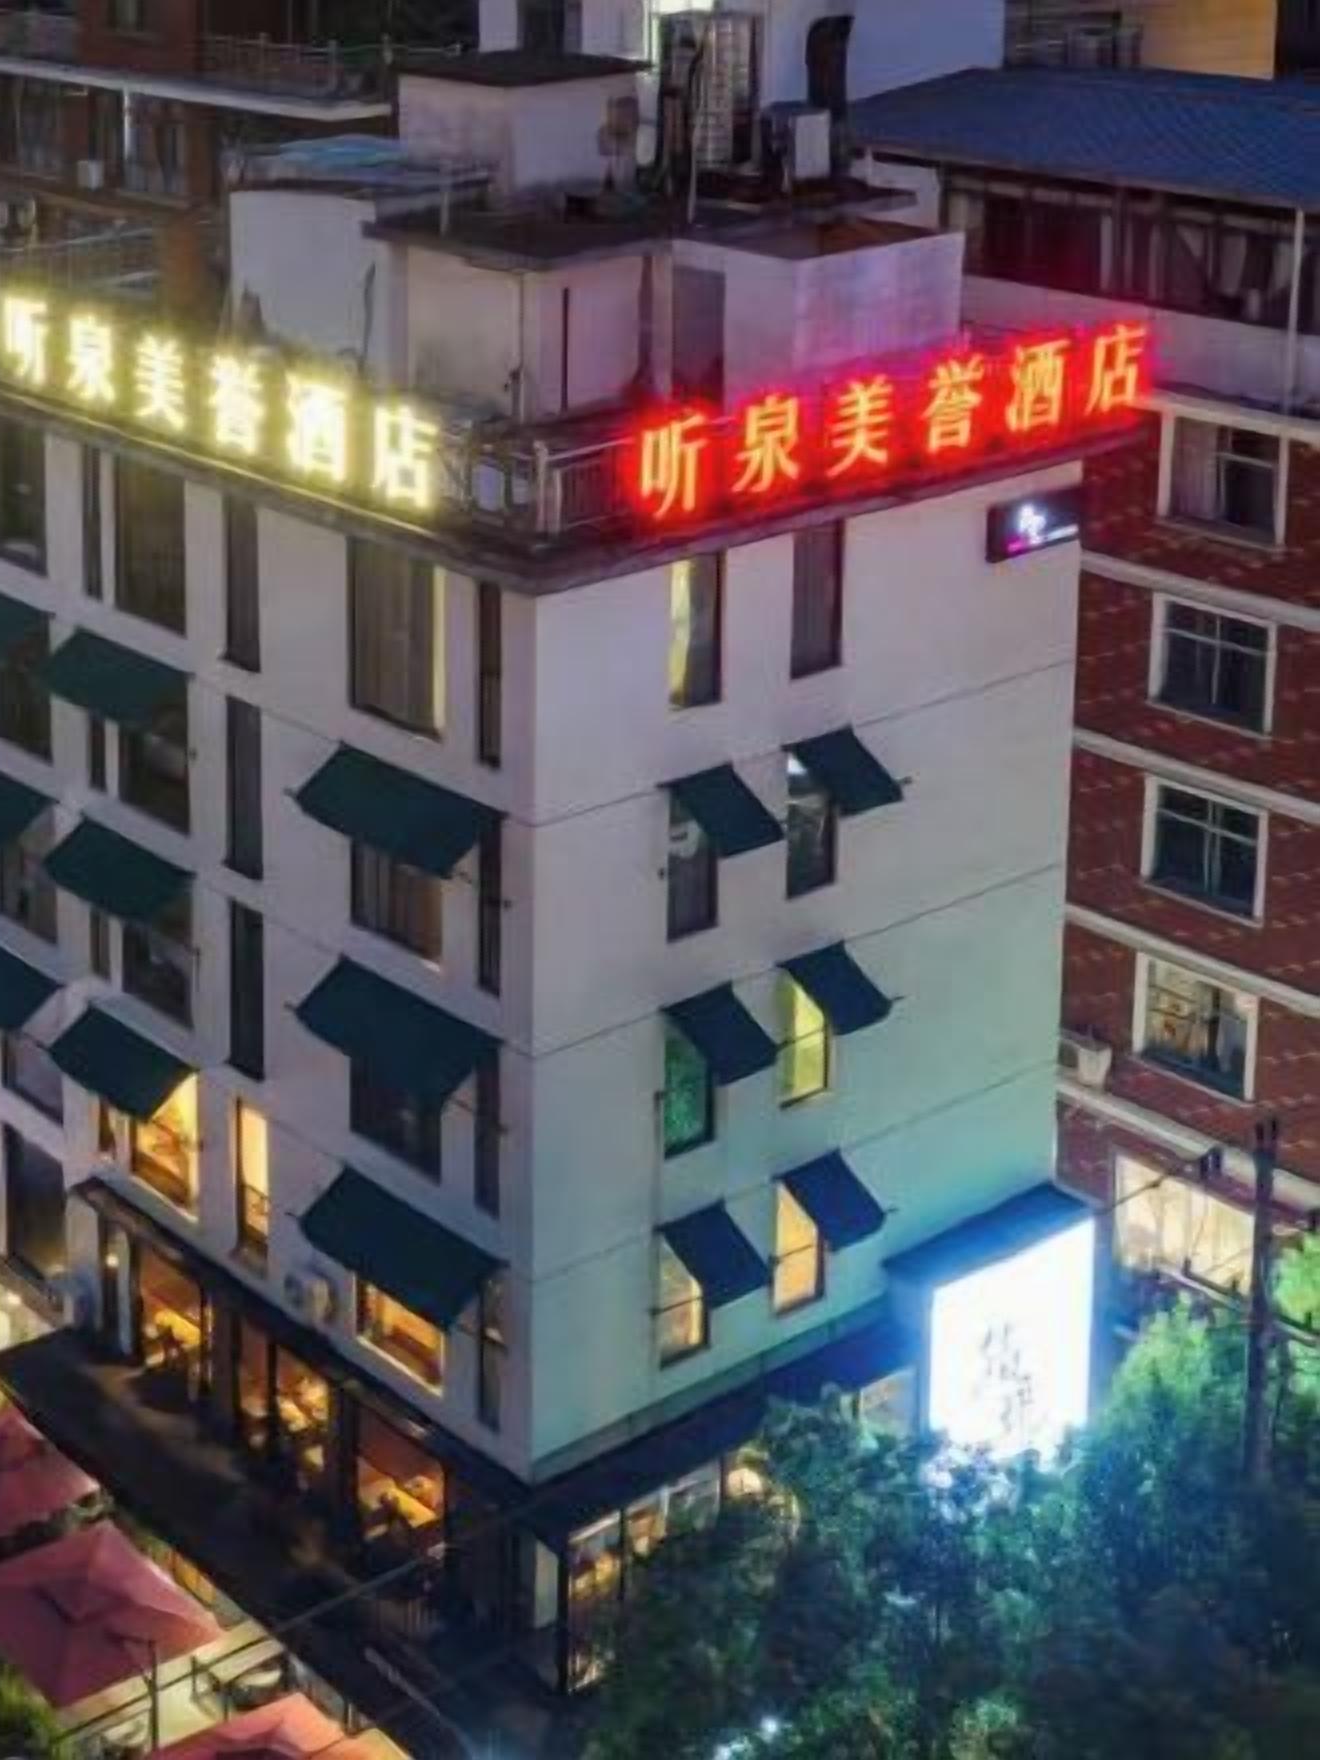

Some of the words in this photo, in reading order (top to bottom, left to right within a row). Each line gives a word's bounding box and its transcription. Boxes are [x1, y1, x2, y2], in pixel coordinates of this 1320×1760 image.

[2, 297, 437, 507] 听泉美誉酒店
[638, 324, 1148, 518] 听泉美誉酒店
